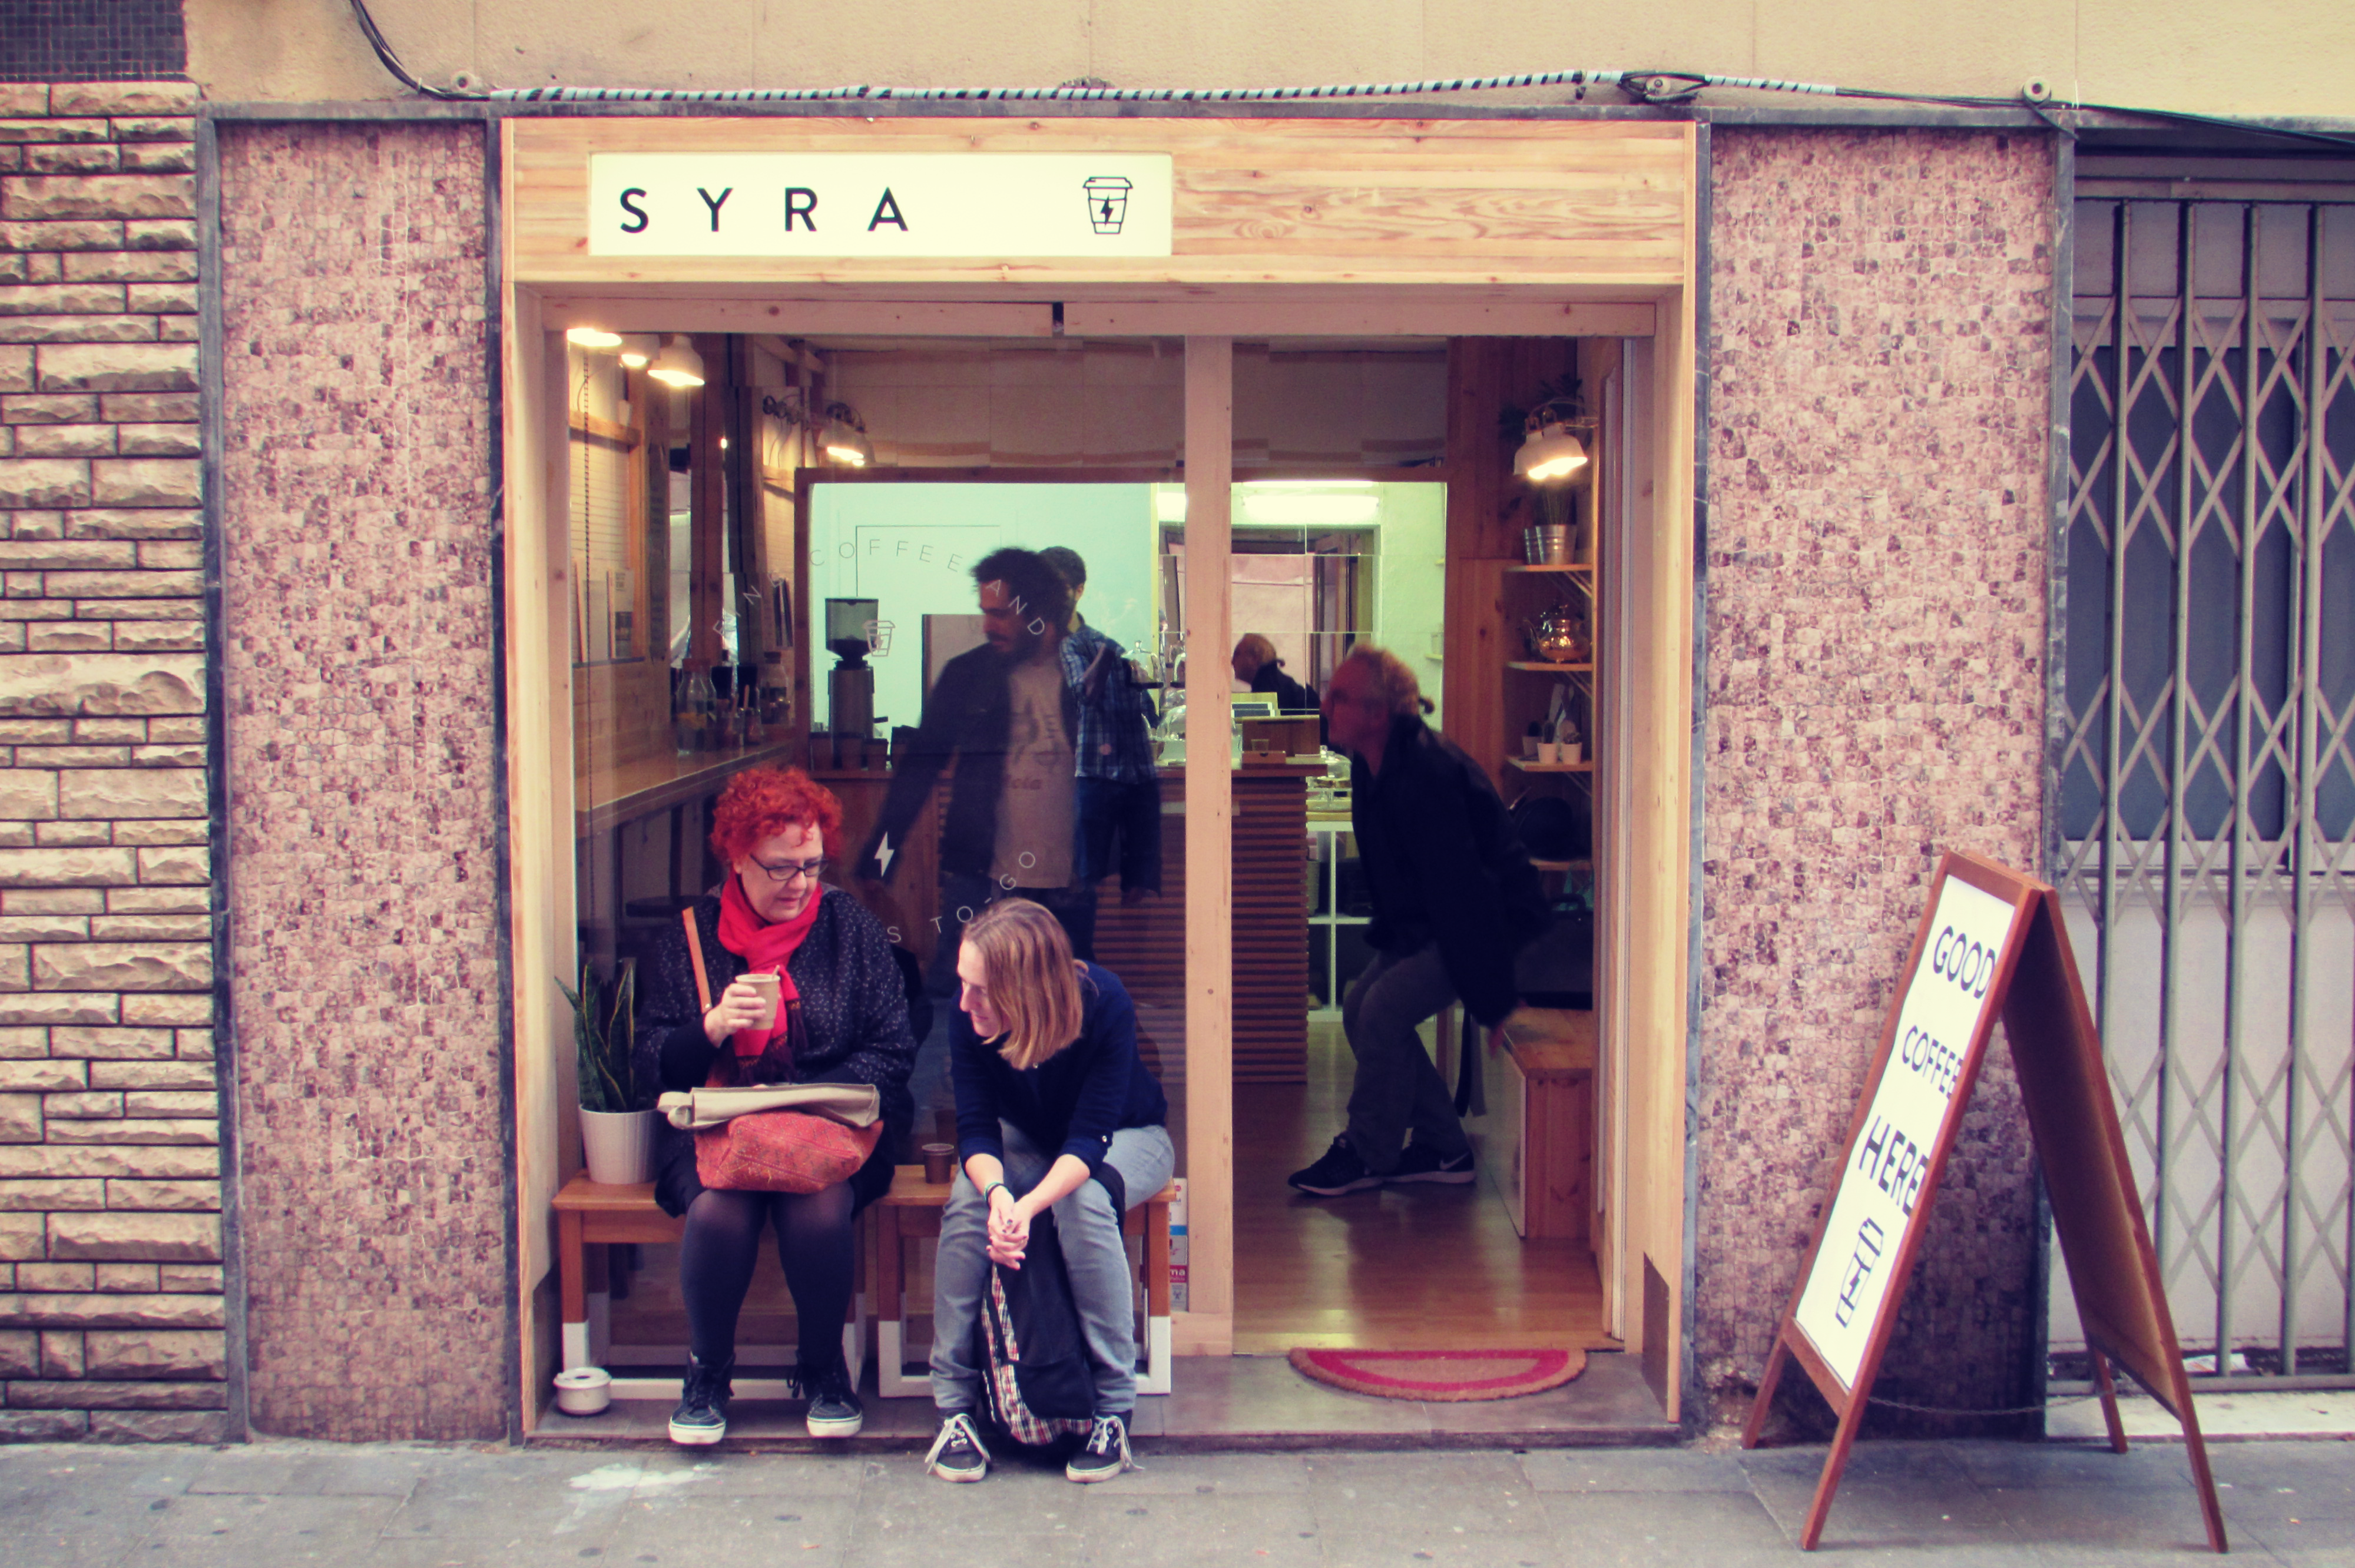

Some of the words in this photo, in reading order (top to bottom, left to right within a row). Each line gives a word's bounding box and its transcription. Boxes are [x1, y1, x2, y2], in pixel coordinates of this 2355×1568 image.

[620, 187, 909, 234] SYRA
[810, 539, 963, 573] COFFEE
[985, 579, 1045, 635] AND
[929, 851, 1036, 934] TO-GO
[1933, 925, 1996, 1000] GOOD
[1902, 1025, 1964, 1100] COFFEE
[1859, 1115, 1930, 1218] HERE
